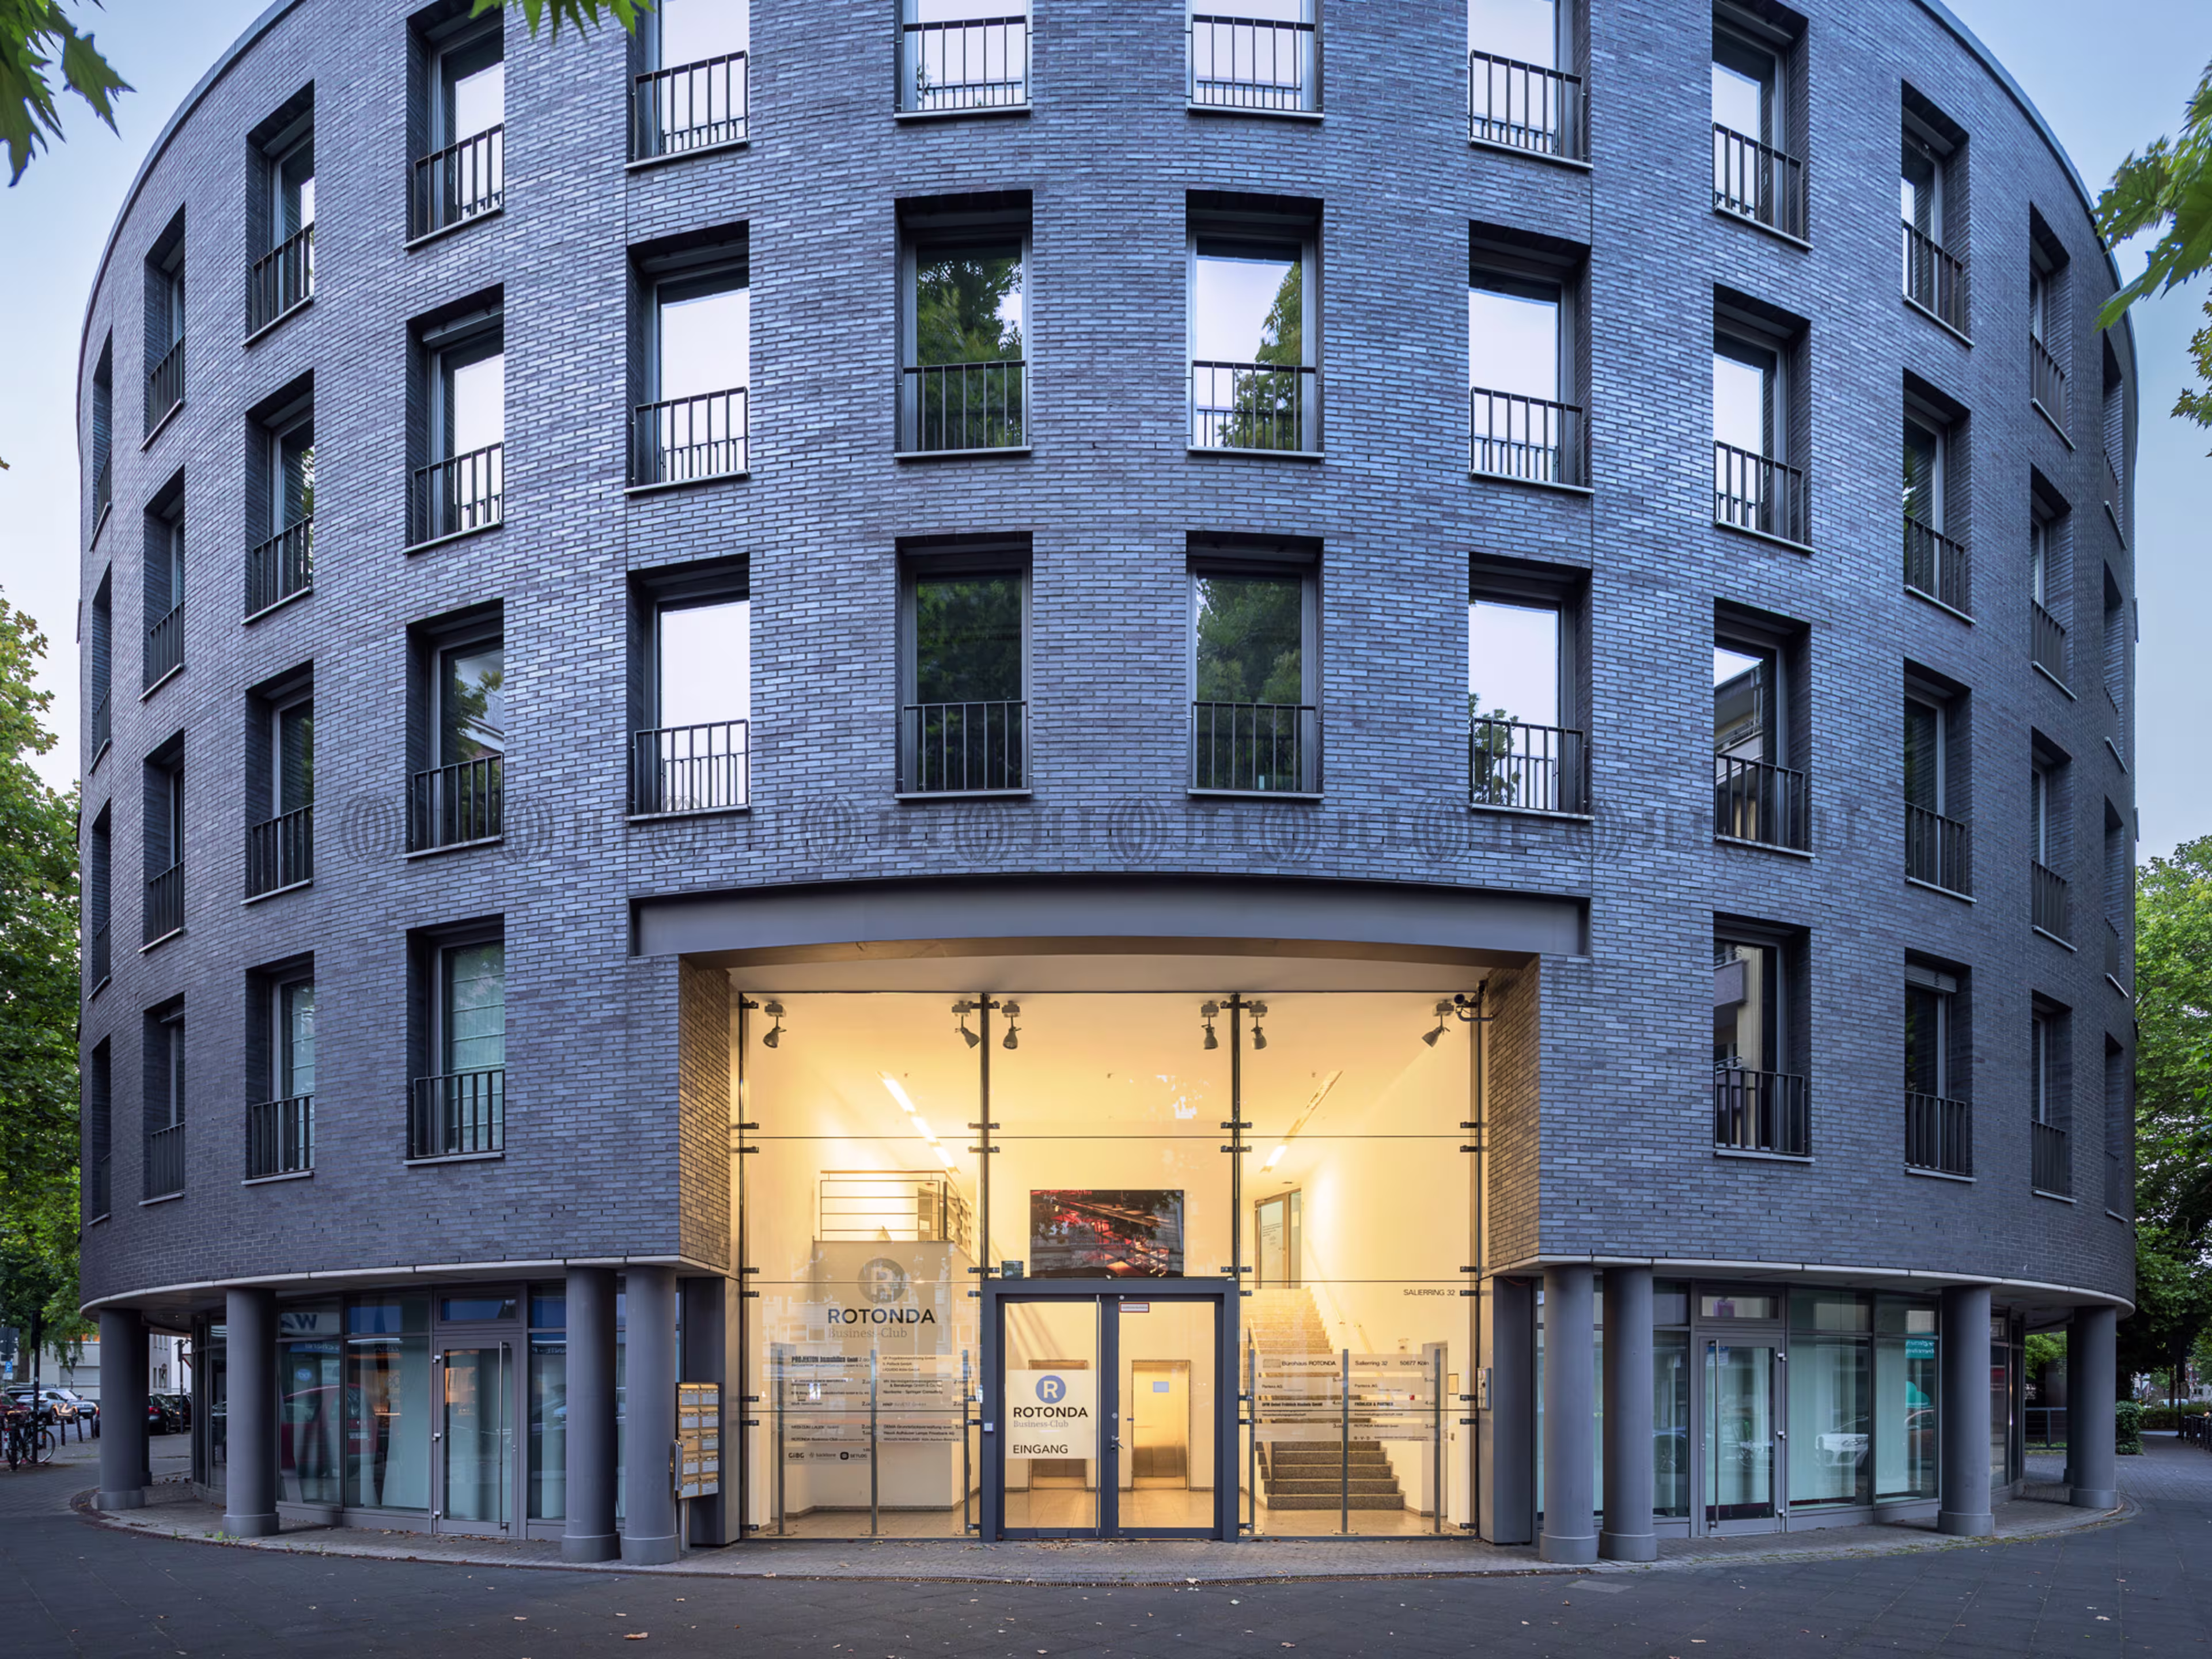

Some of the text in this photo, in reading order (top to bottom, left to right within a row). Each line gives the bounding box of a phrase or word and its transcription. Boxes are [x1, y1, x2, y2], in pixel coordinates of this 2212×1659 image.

[828, 1309, 935, 1324] ROTONDA
[1043, 1380, 1058, 1399] R
[1013, 1407, 1088, 1418] ROTONDA
[1013, 1445, 1068, 1454] EINGANG
